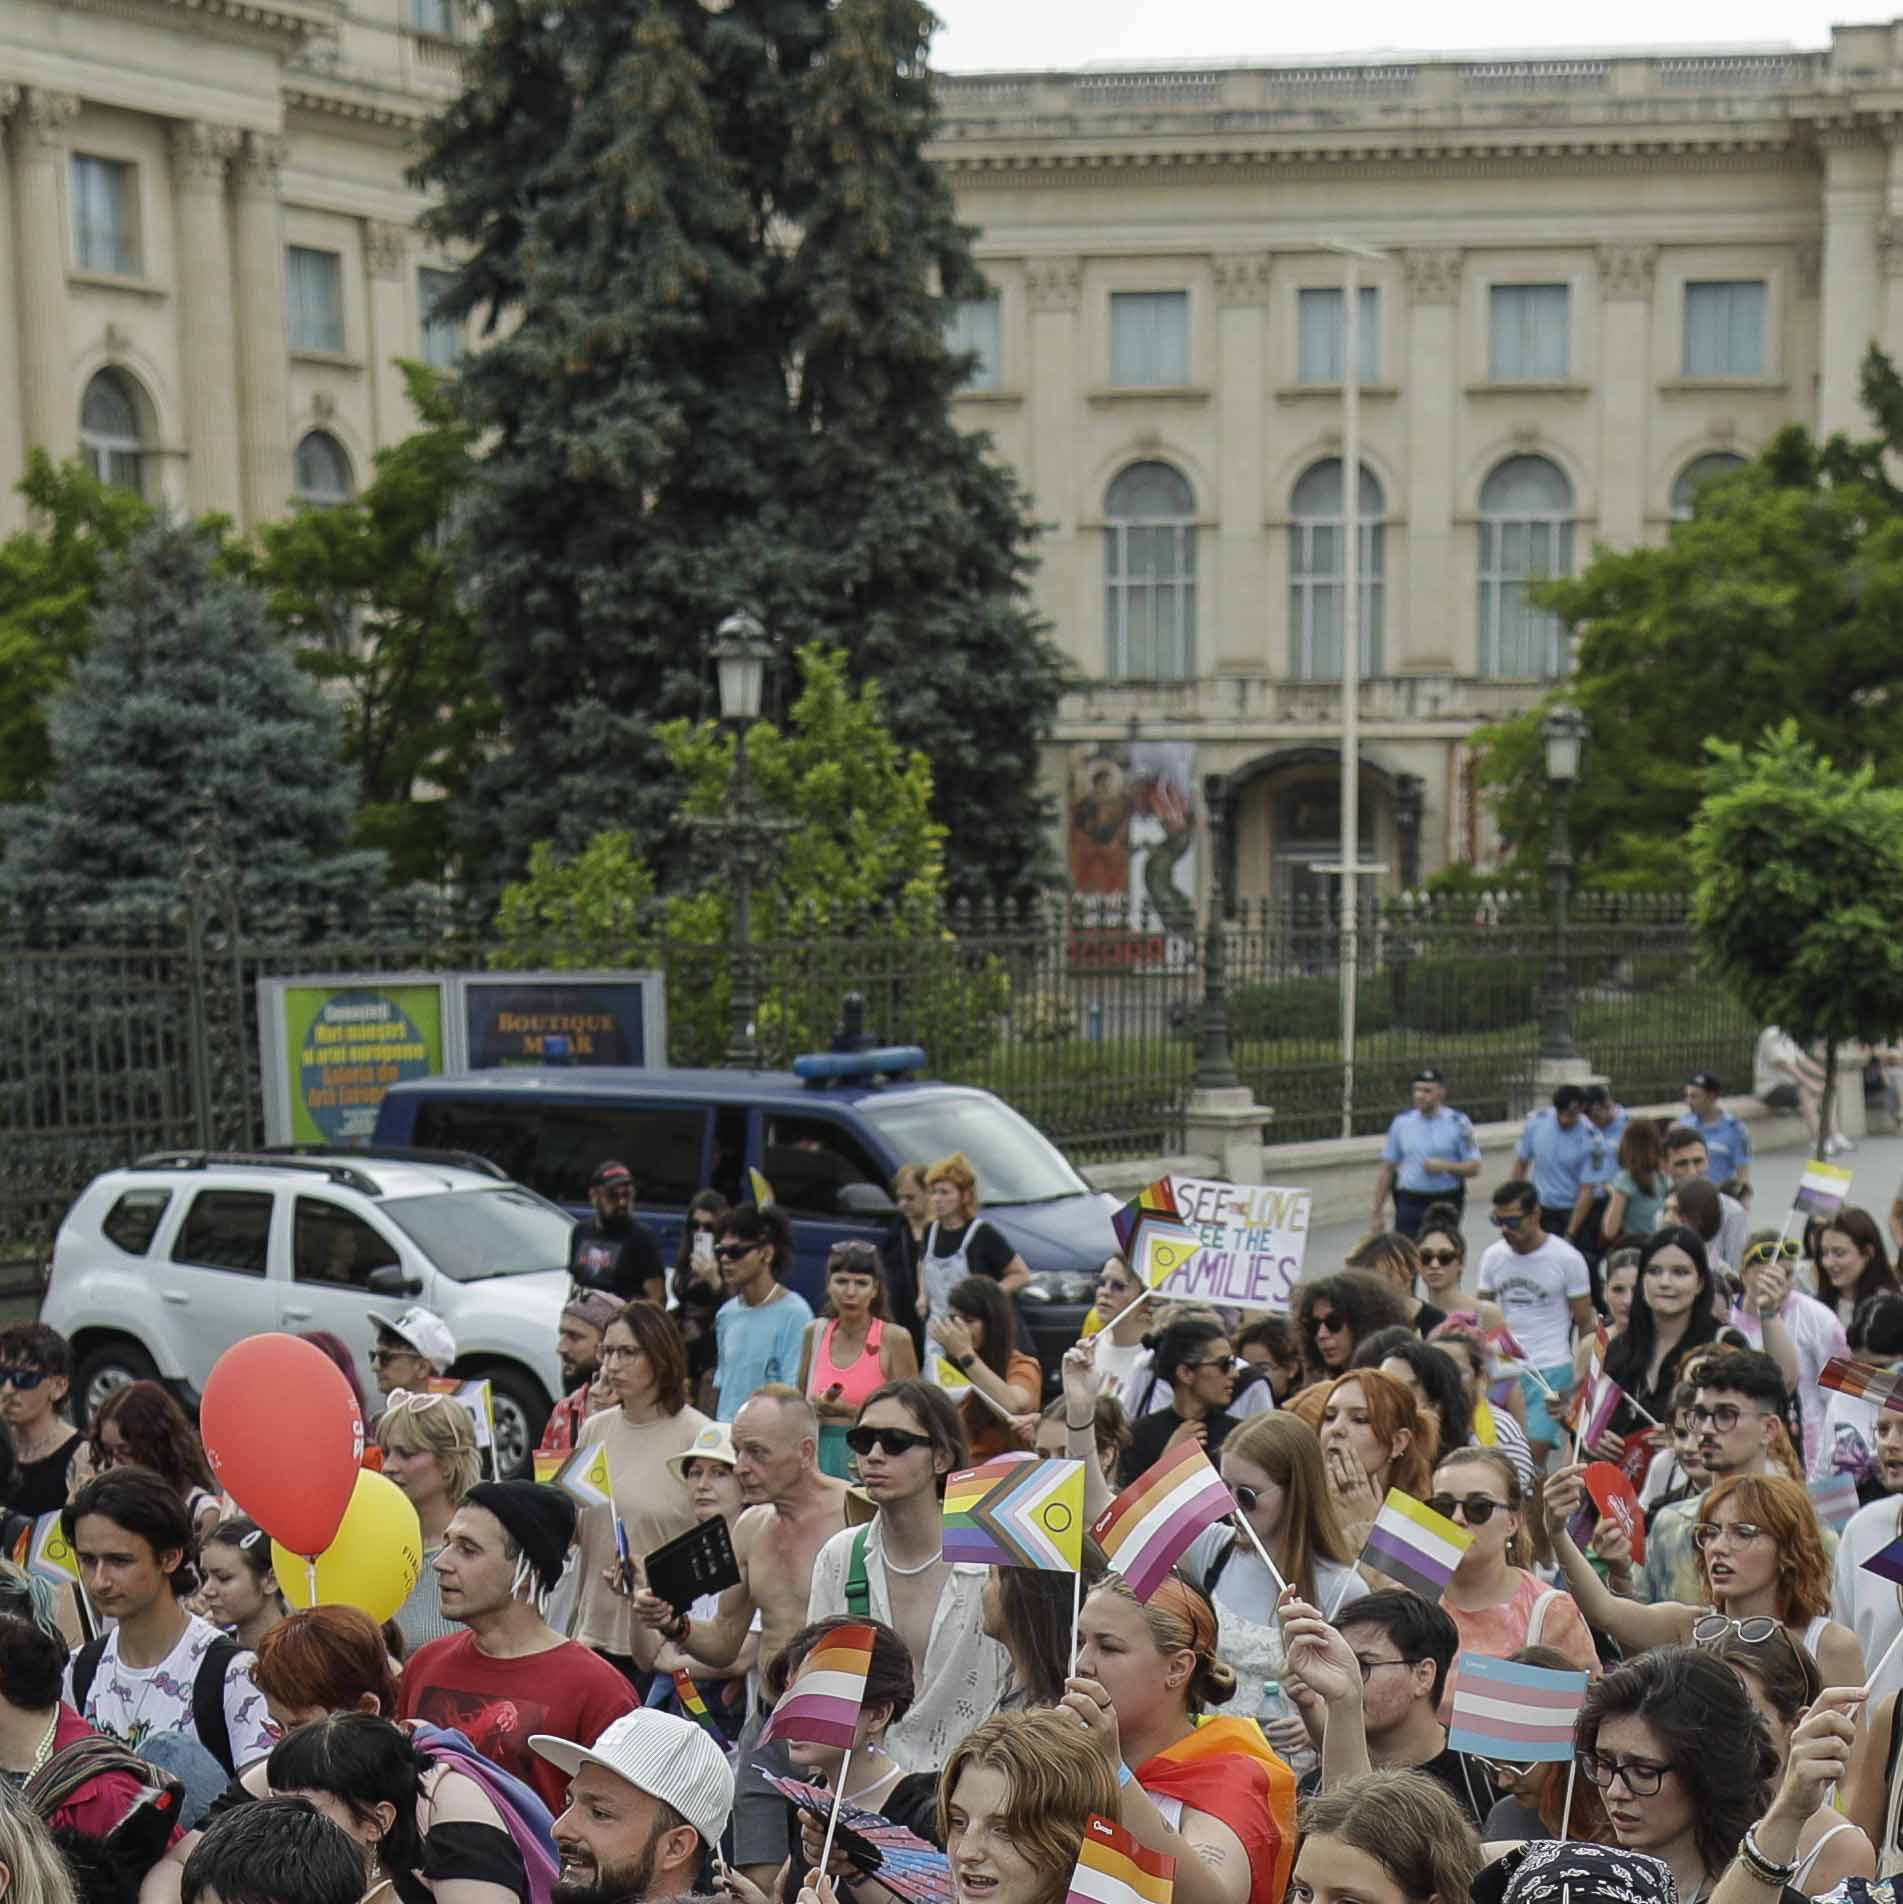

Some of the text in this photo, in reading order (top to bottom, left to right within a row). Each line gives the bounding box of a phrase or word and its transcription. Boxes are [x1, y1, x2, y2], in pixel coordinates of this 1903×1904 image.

[1177, 1184, 1234, 1227] SEE
[1243, 1189, 1311, 1232] LOVE
[1199, 1226, 1273, 1251] EE THE
[1158, 1251, 1297, 1303] AMILIES
